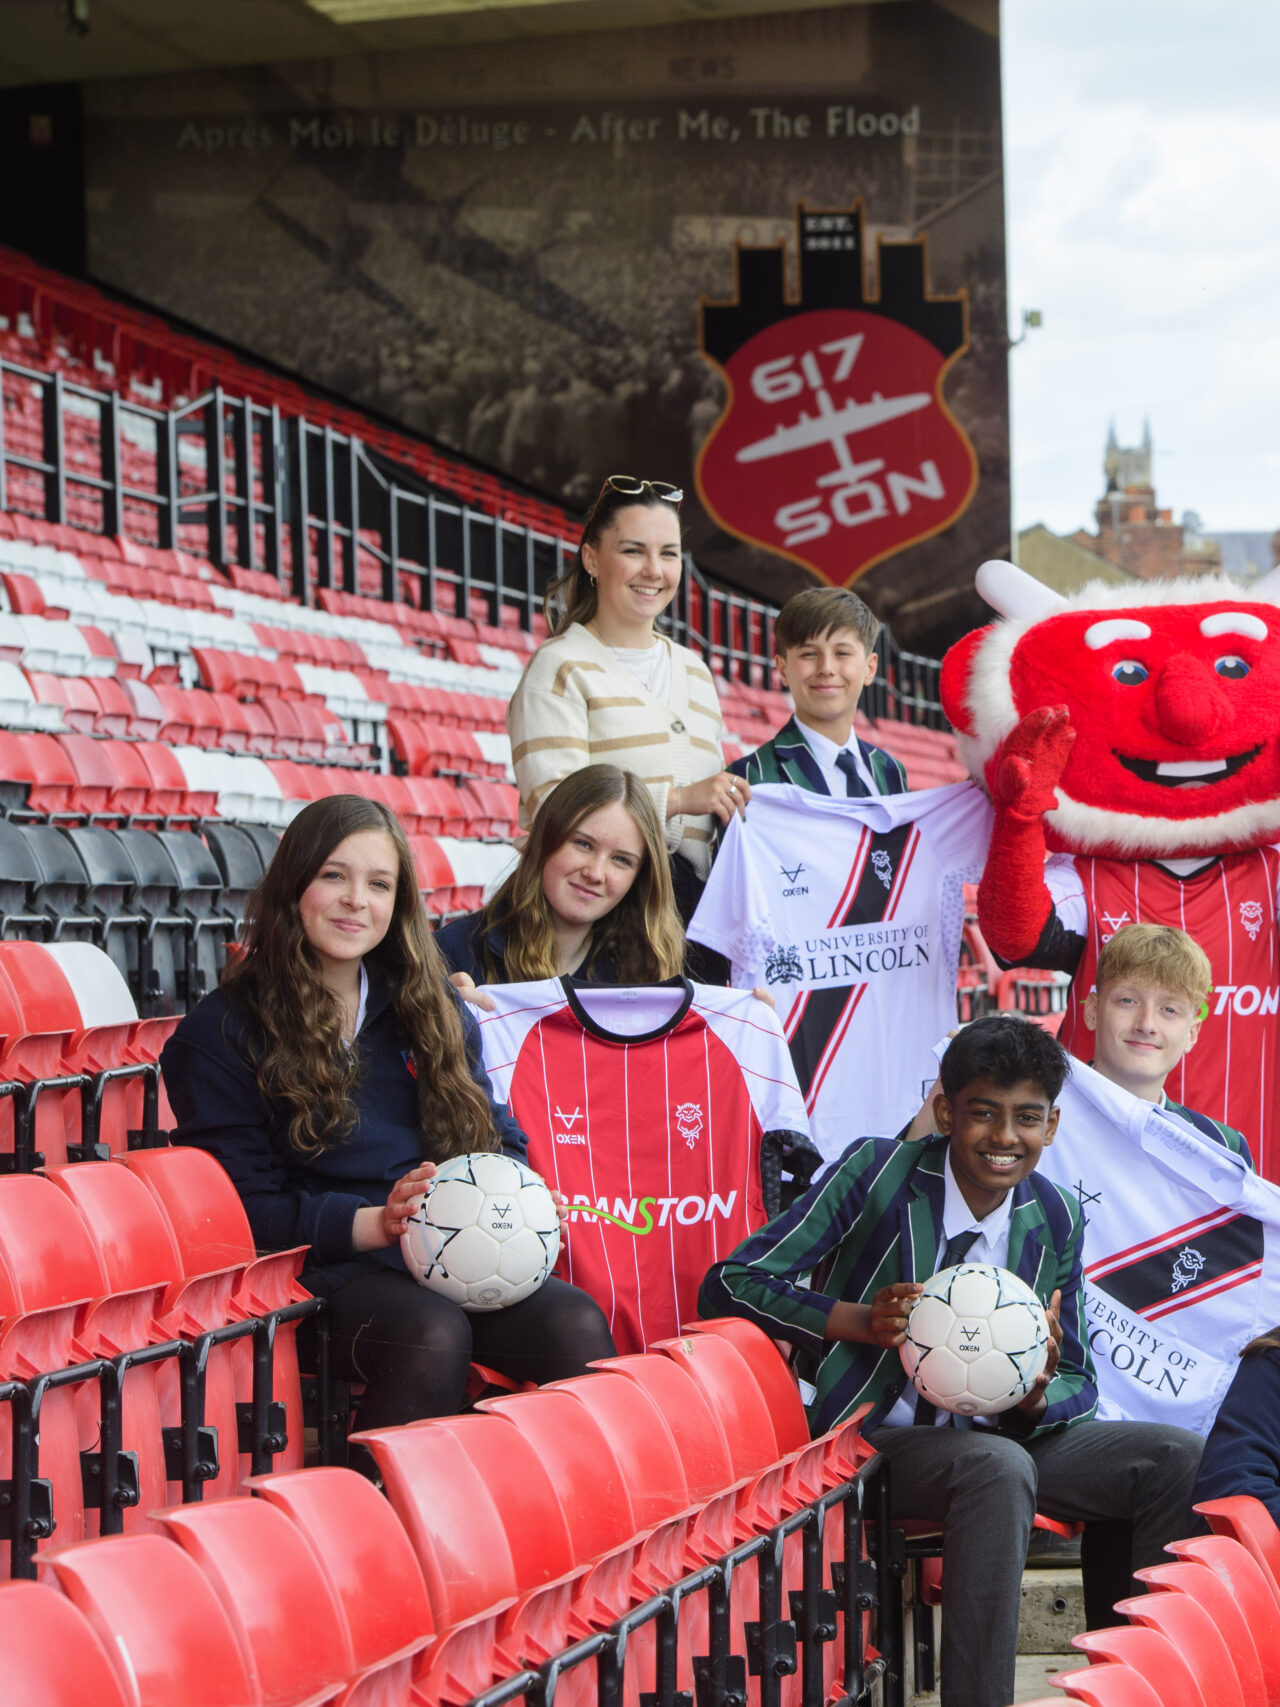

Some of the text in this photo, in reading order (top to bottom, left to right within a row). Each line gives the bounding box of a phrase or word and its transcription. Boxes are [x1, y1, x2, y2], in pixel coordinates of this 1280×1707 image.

[570, 111, 662, 143] After
[678, 109, 742, 144] Me,
[750, 107, 811, 140] The
[826, 103, 922, 138] Flood
[751, 332, 866, 404] 617
[774, 459, 946, 548] SQN
[782, 886, 809, 898] OXEN
[805, 924, 930, 953] UNIVERSITY OF
[807, 942, 930, 981] LINCOLN
[556, 1133, 586, 1146] OXEN
[491, 1222, 513, 1230] OXEN
[958, 1344, 981, 1352] OXEN
[1167, 1350, 1197, 1372] OF
